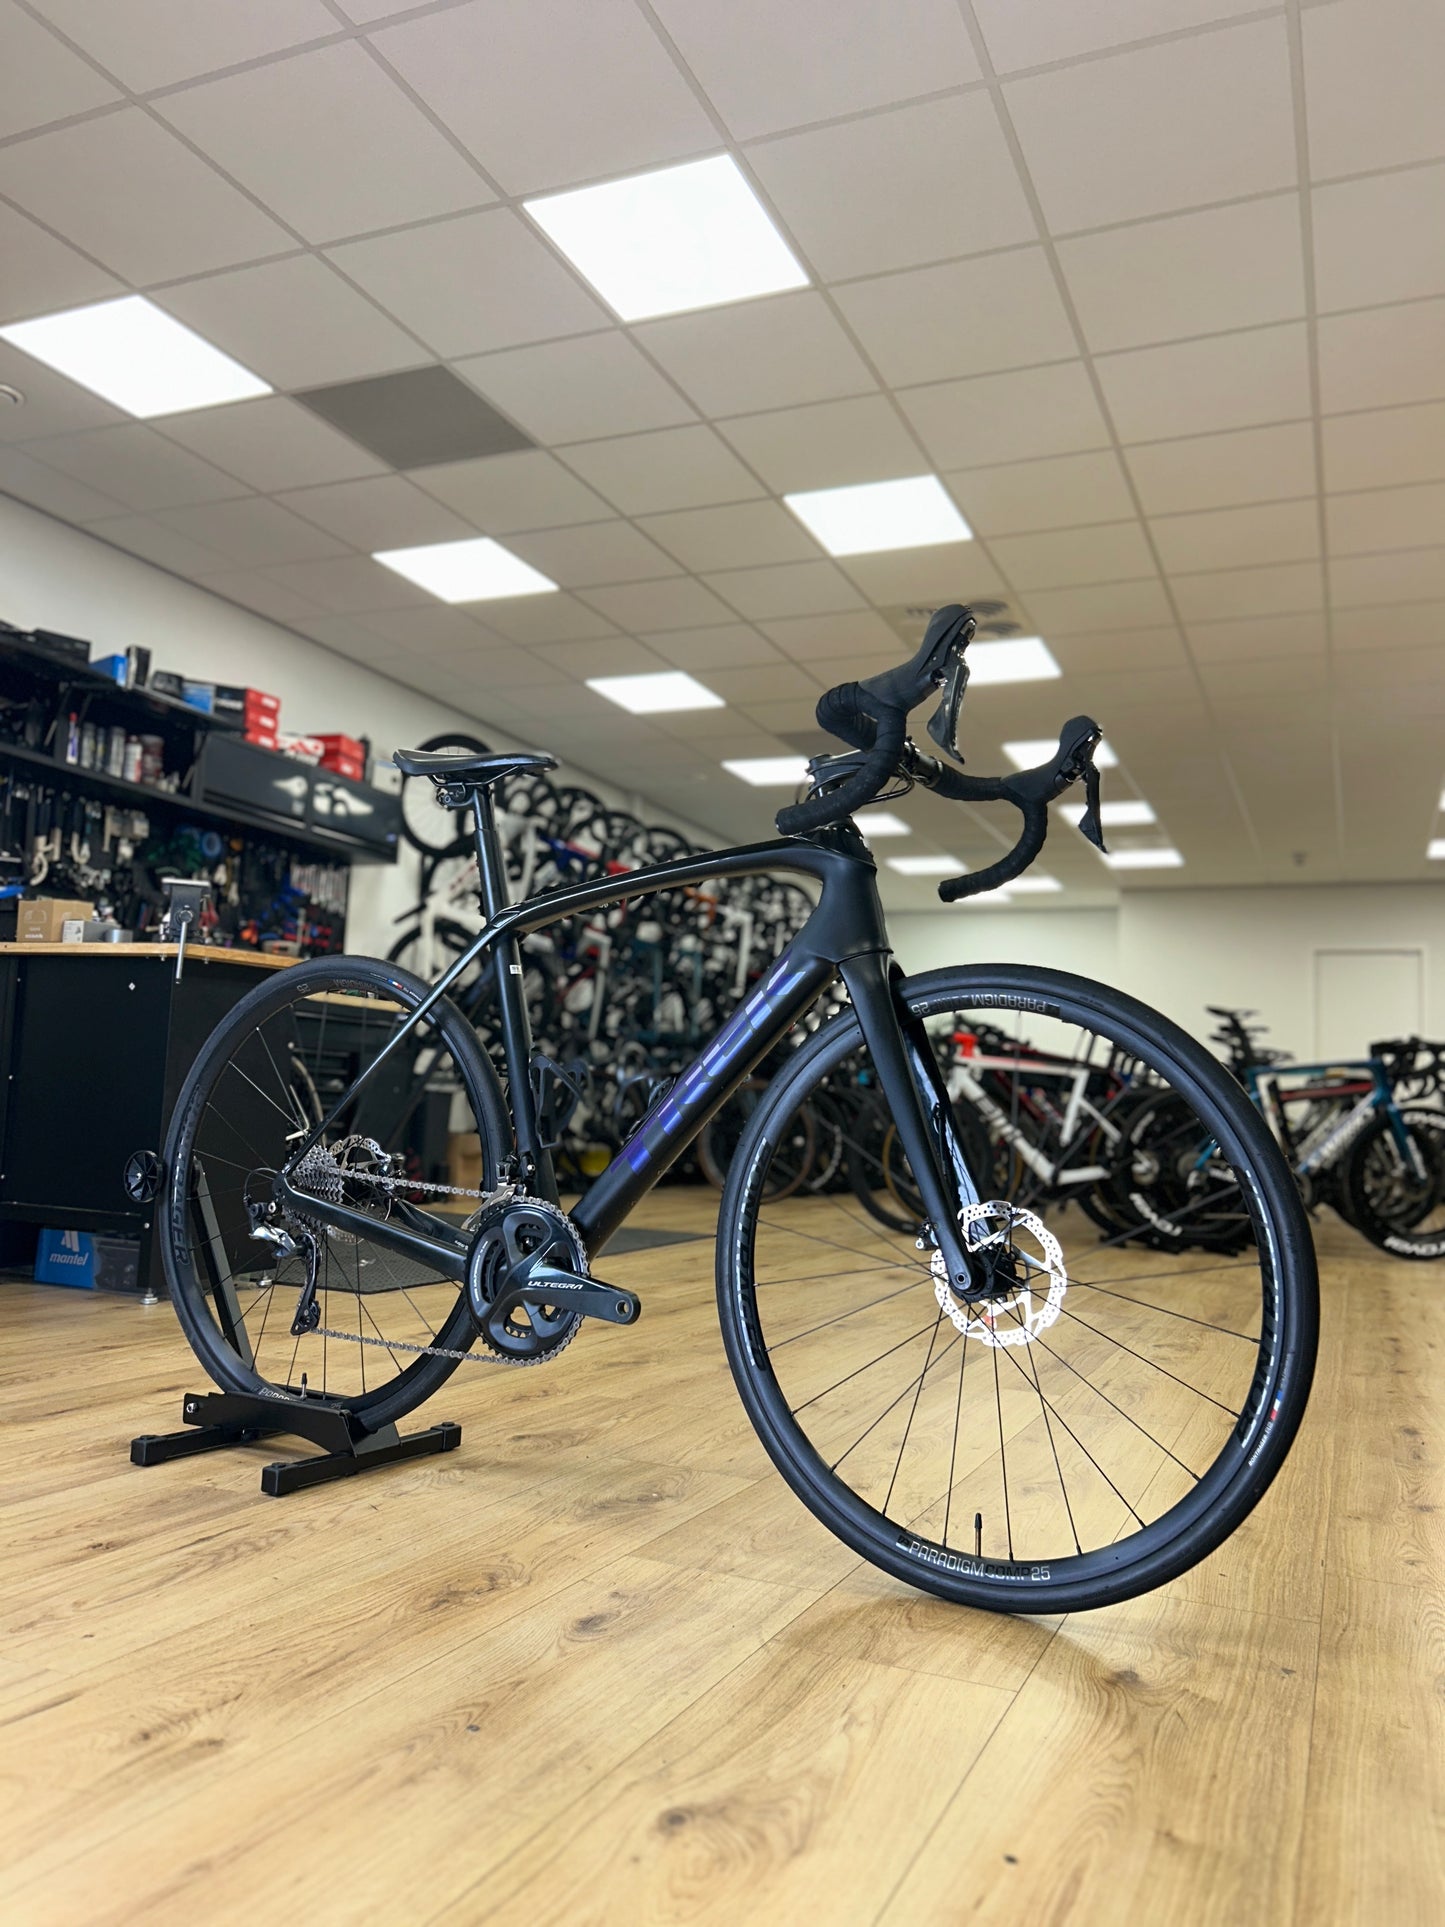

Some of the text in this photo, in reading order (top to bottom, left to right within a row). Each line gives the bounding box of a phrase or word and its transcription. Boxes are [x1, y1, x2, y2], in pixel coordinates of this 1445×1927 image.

[911, 1001, 929, 1016] 25
[971, 993, 1046, 1013] PARADIGM
[610, 950, 806, 1174] TREK
[49, 1253, 89, 1266] mantel
[527, 1280, 583, 1290] ULTEGRA
[908, 1540, 985, 1577] PARADIGM
[984, 1563, 1031, 1581] COMP
[1030, 1565, 1051, 1581] 25
